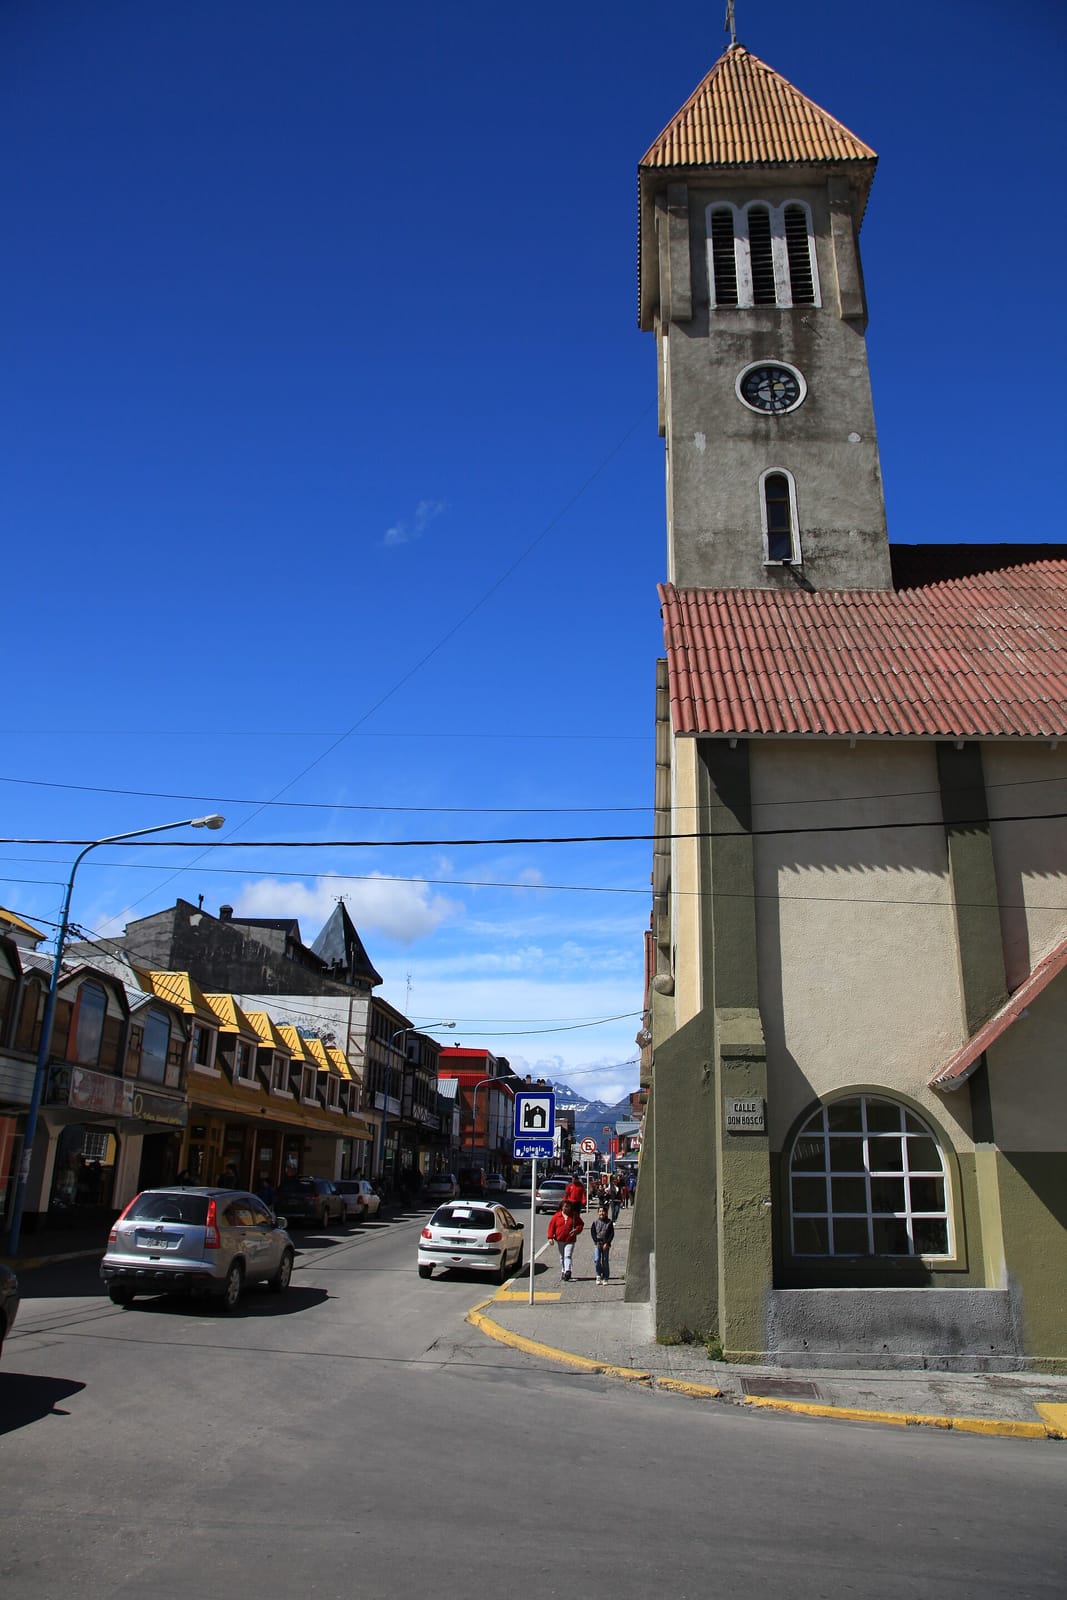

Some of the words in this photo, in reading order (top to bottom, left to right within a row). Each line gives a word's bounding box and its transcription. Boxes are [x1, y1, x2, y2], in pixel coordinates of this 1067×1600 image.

[734, 1103, 756, 1112] CALLE
[727, 1116, 741, 1125] DON
[741, 1116, 763, 1125] BOSCO
[523, 1145, 545, 1153] Iglesia
